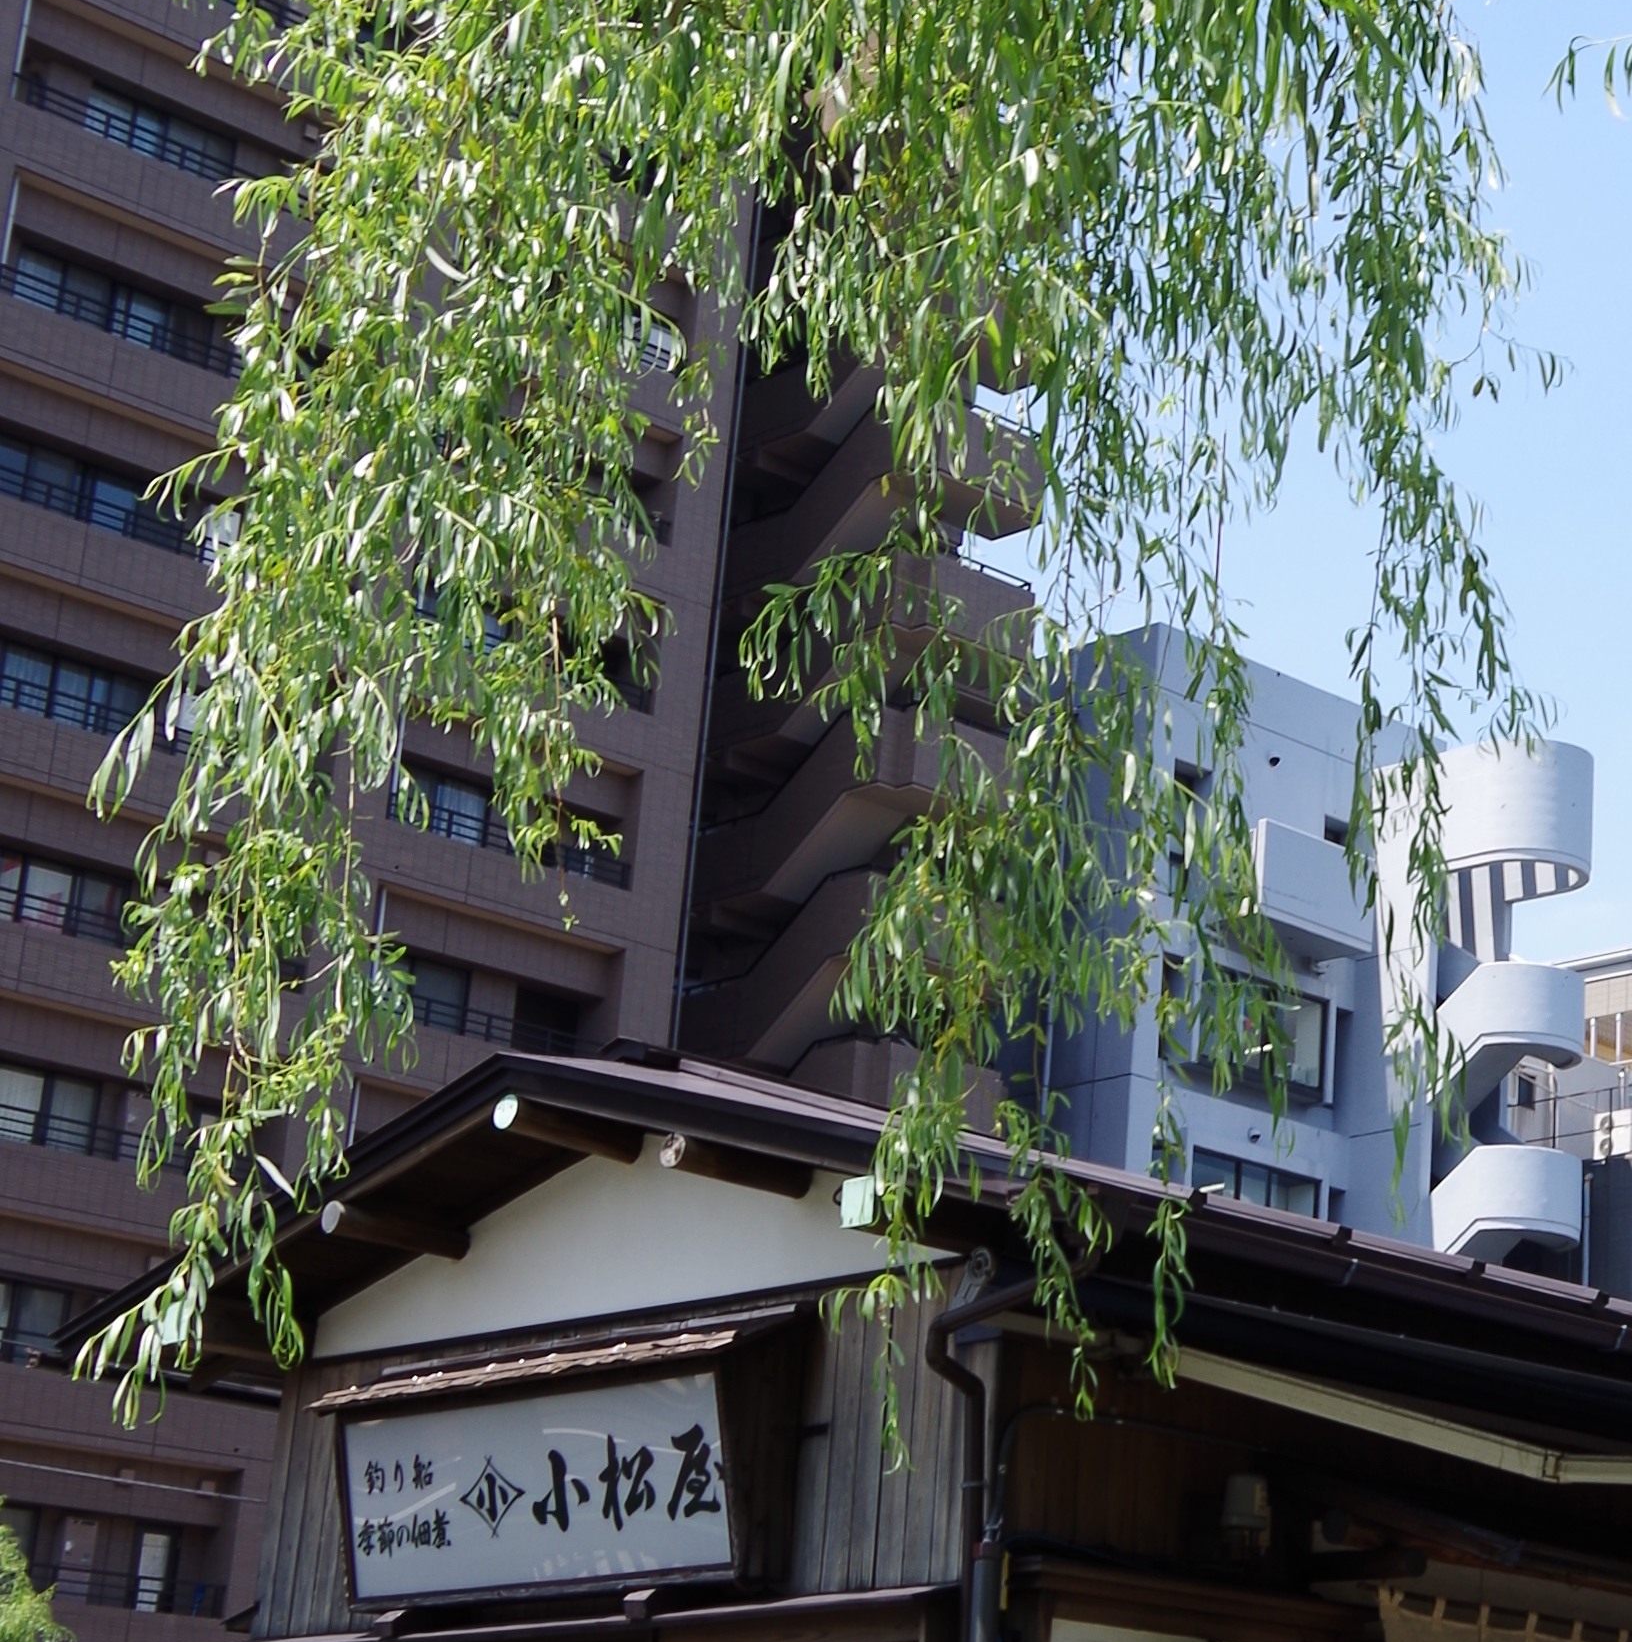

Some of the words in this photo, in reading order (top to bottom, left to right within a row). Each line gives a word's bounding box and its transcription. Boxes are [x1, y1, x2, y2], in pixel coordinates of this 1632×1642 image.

[364, 1453, 434, 1495] 釣り船
[531, 1423, 724, 1533] 小松屋
[356, 1509, 452, 1559] 季節の佃煮
